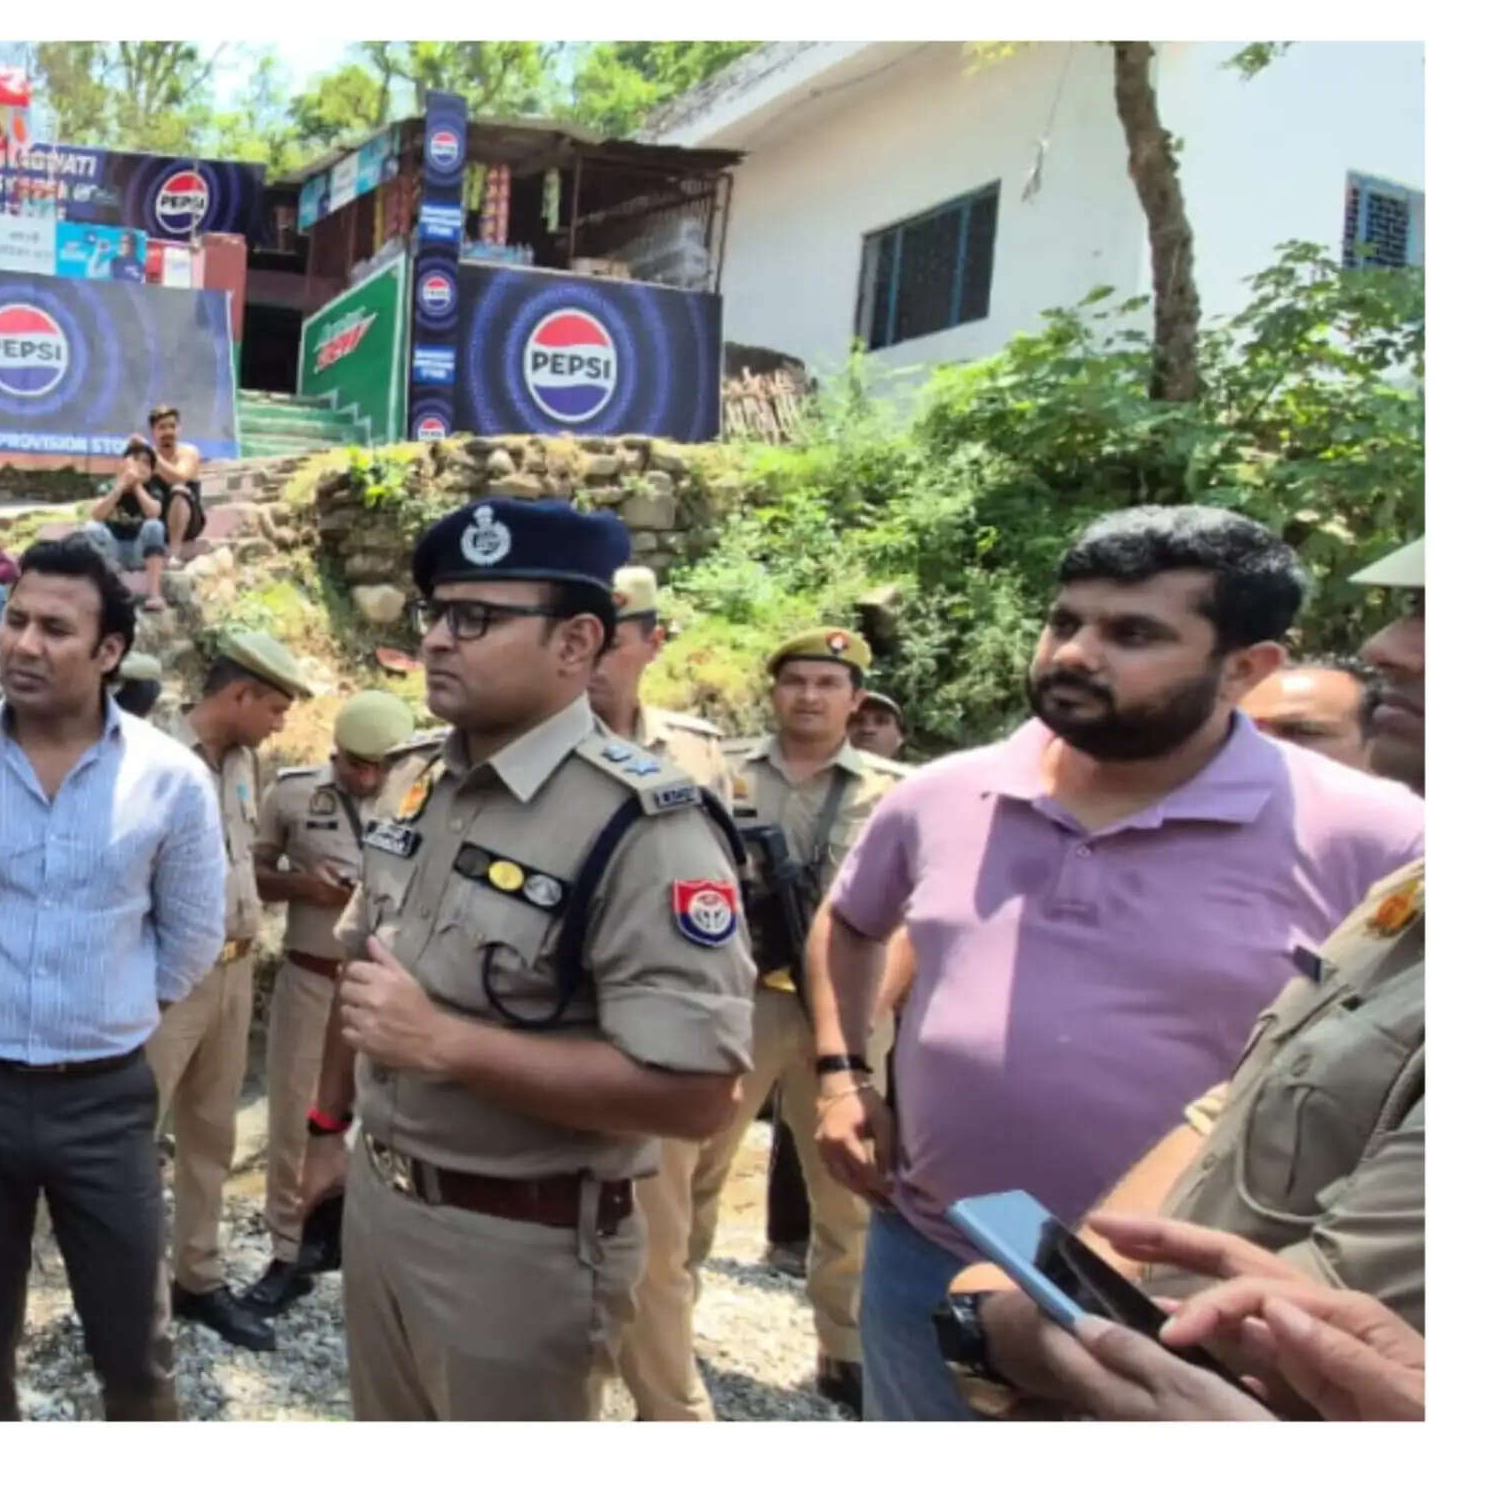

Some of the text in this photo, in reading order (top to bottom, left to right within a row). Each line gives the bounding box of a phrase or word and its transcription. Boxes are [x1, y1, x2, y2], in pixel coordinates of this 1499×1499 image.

[160, 194, 206, 208] PEPSI
[531, 350, 611, 381] PEPSI
[91, 436, 129, 456] STO
